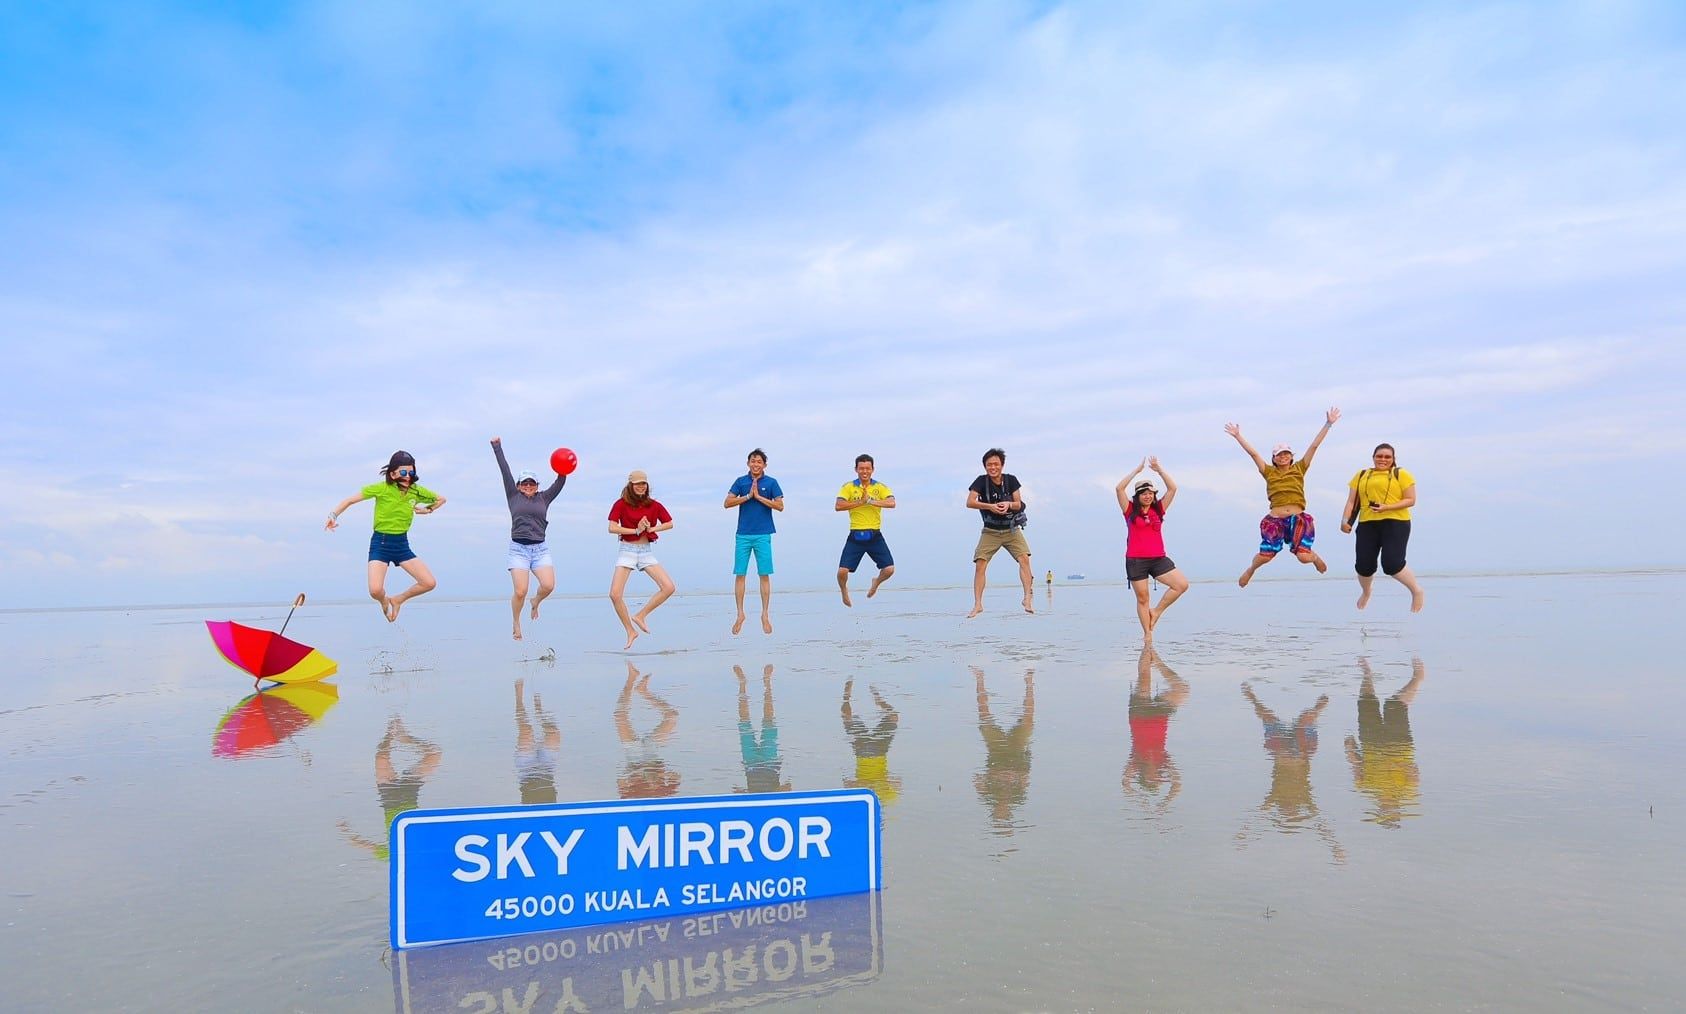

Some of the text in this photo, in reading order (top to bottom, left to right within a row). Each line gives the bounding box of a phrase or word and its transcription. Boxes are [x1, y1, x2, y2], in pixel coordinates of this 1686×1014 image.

[452, 816, 832, 883] SKY MIRROR
[485, 877, 807, 920] 45000 KUALA SELANGOR
